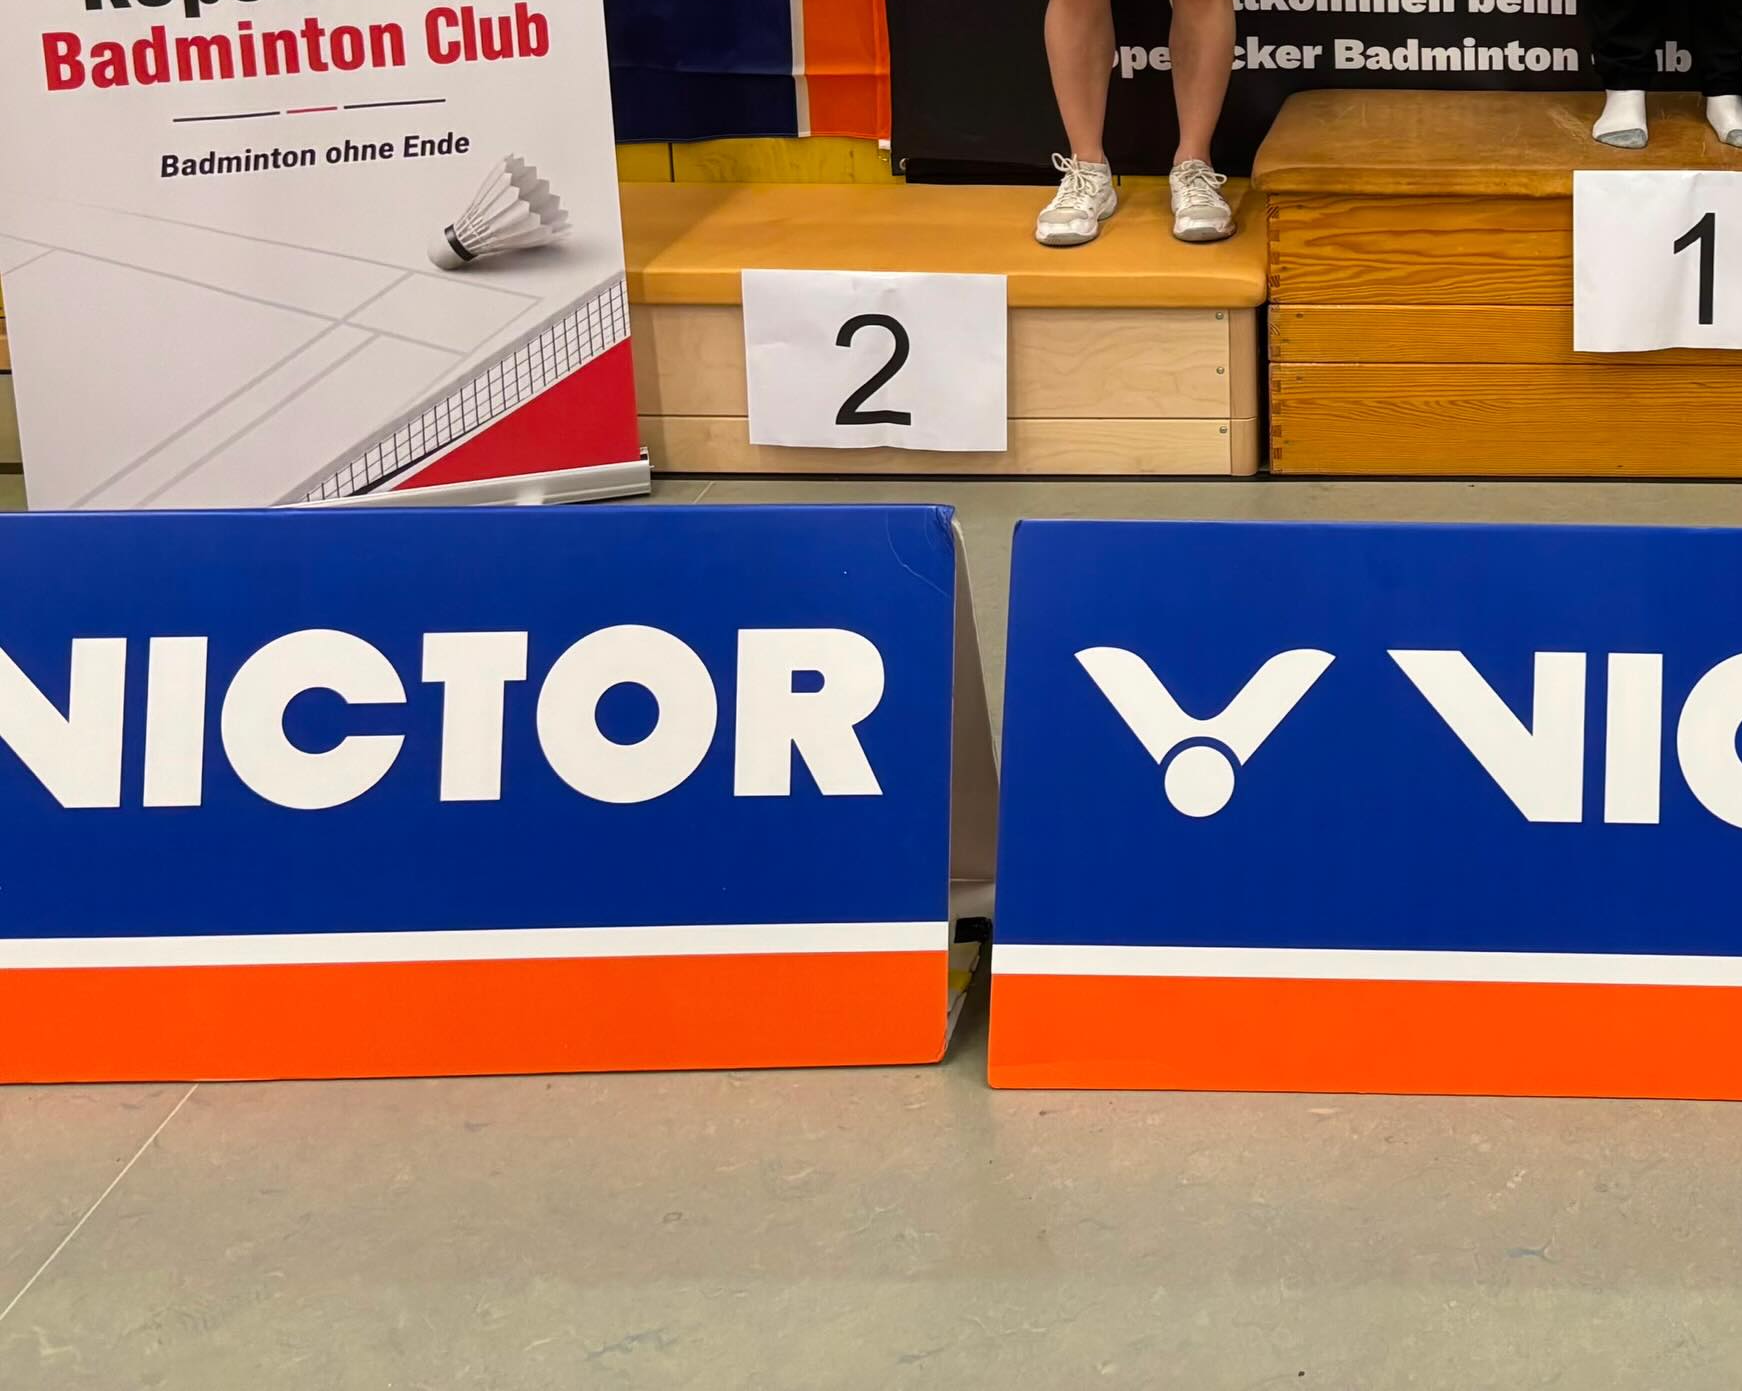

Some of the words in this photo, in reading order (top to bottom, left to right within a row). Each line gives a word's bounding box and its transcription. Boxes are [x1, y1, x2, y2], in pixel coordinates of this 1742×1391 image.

[42, 19, 407, 91] Badminton
[425, 2, 550, 66] Club
[1334, 37, 1579, 71] Badminton
[160, 145, 317, 178] Badminton
[326, 136, 394, 163] ohne
[403, 133, 470, 158] Ende
[1672, 210, 1717, 326] 1
[834, 312, 912, 427] 2
[0, 624, 886, 810] VICTOR
